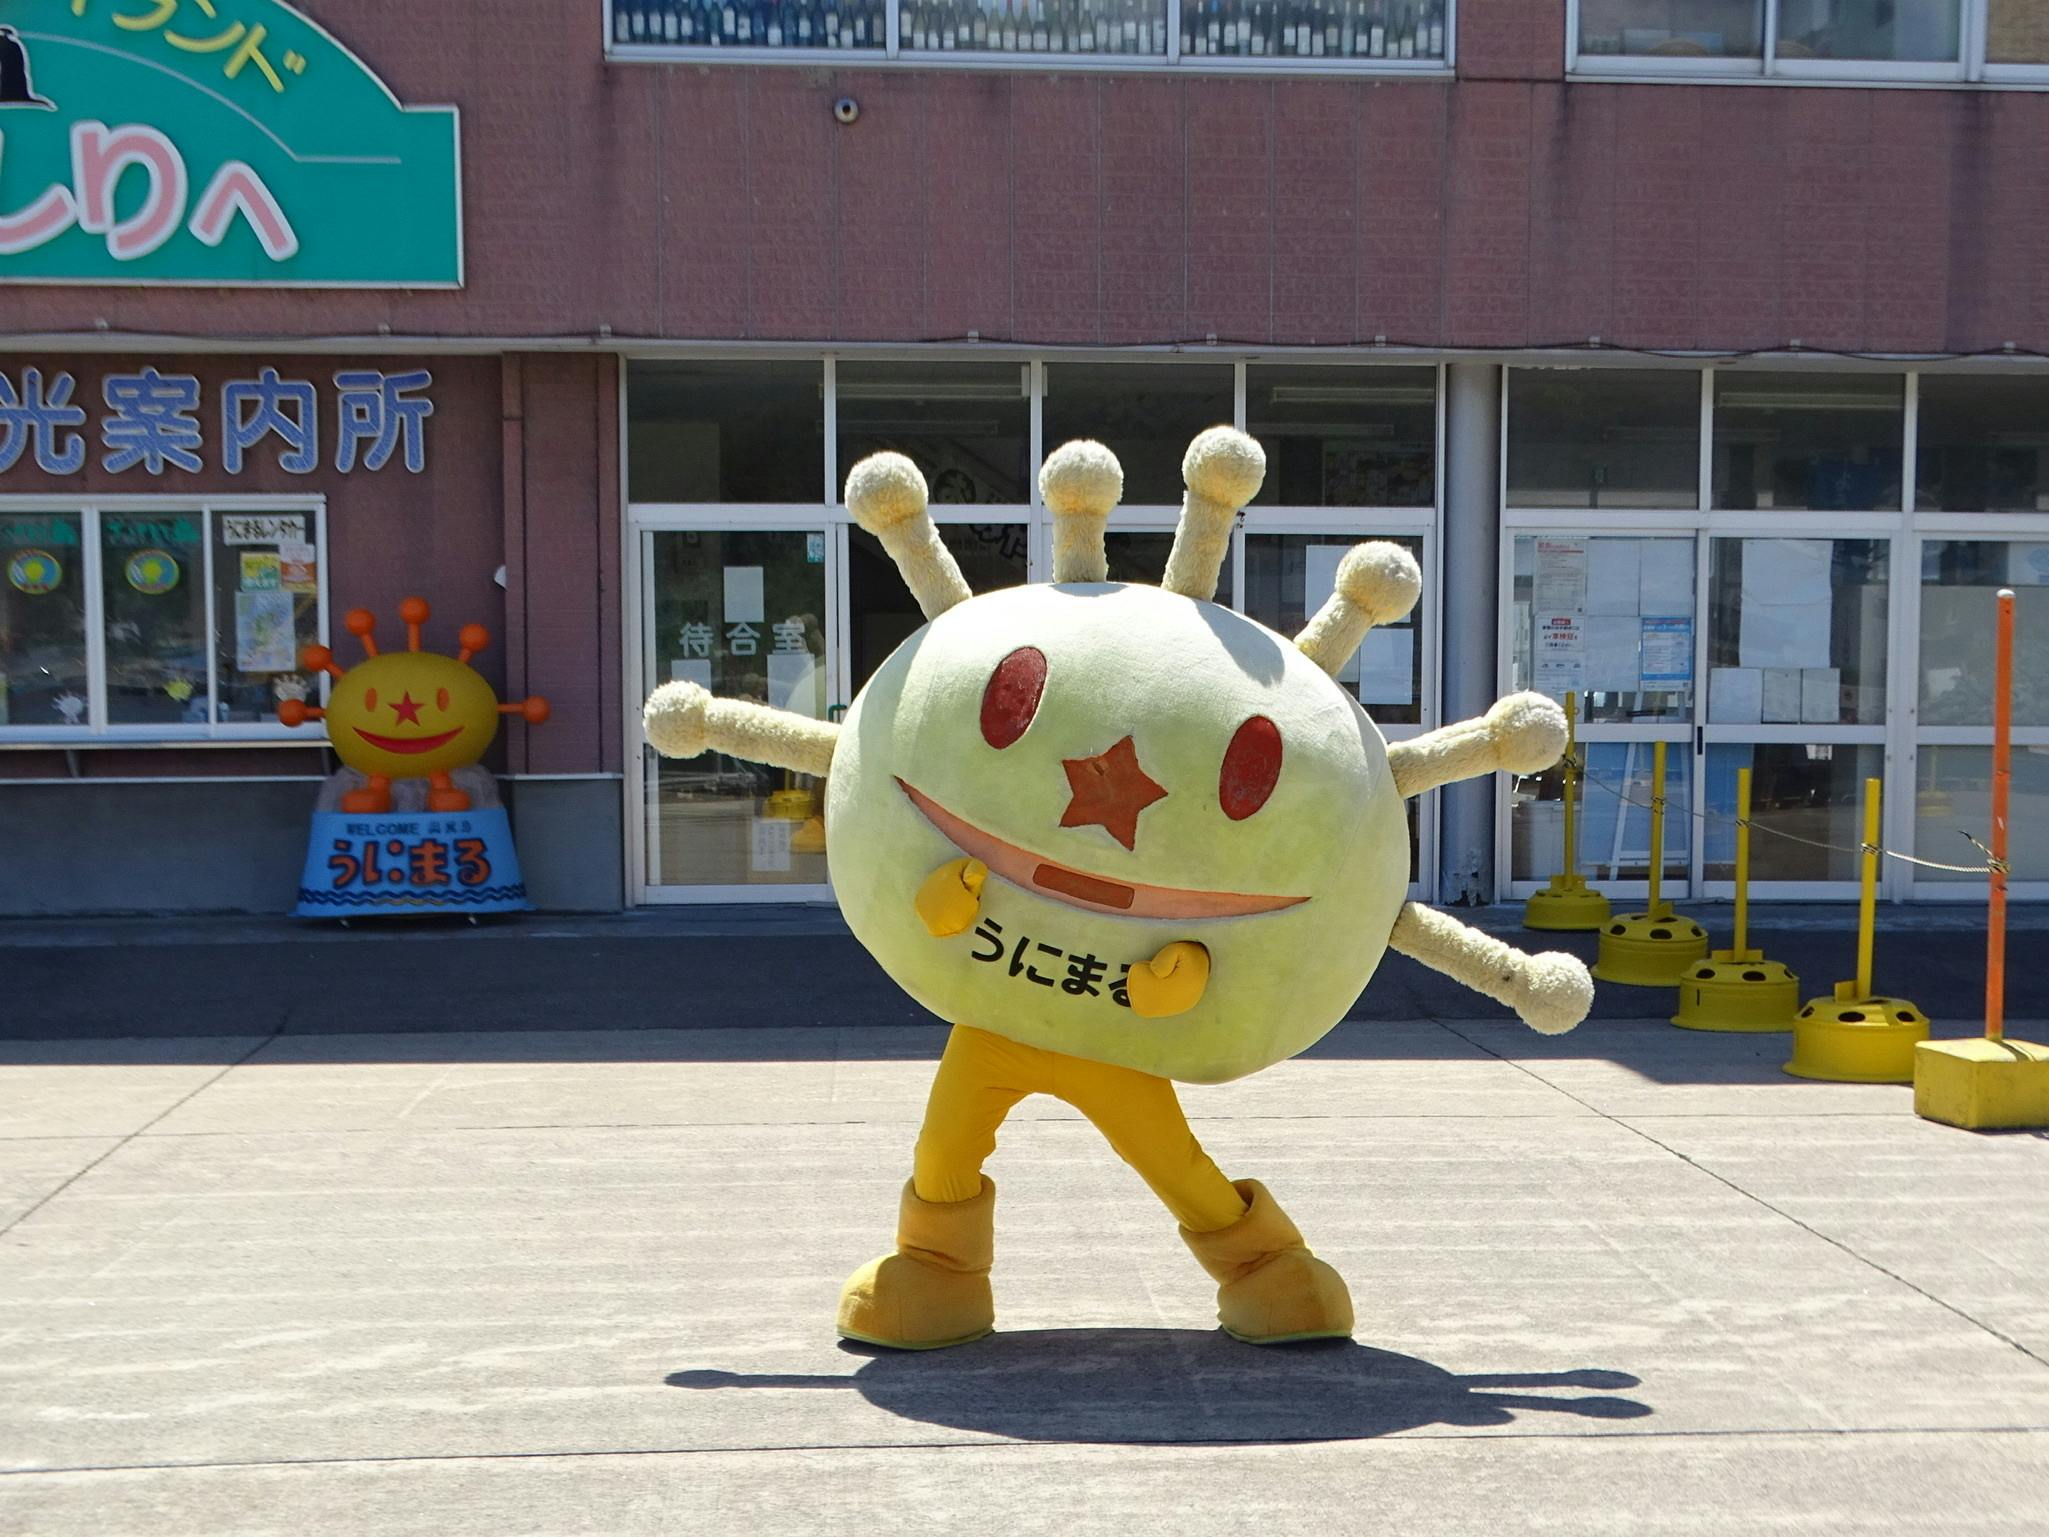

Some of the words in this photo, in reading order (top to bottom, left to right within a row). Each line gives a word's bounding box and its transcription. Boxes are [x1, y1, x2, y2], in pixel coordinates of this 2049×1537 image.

[678, 621, 809, 658] 待合室
[346, 823, 420, 836] WELCOME
[328, 838, 492, 889] うにまる
